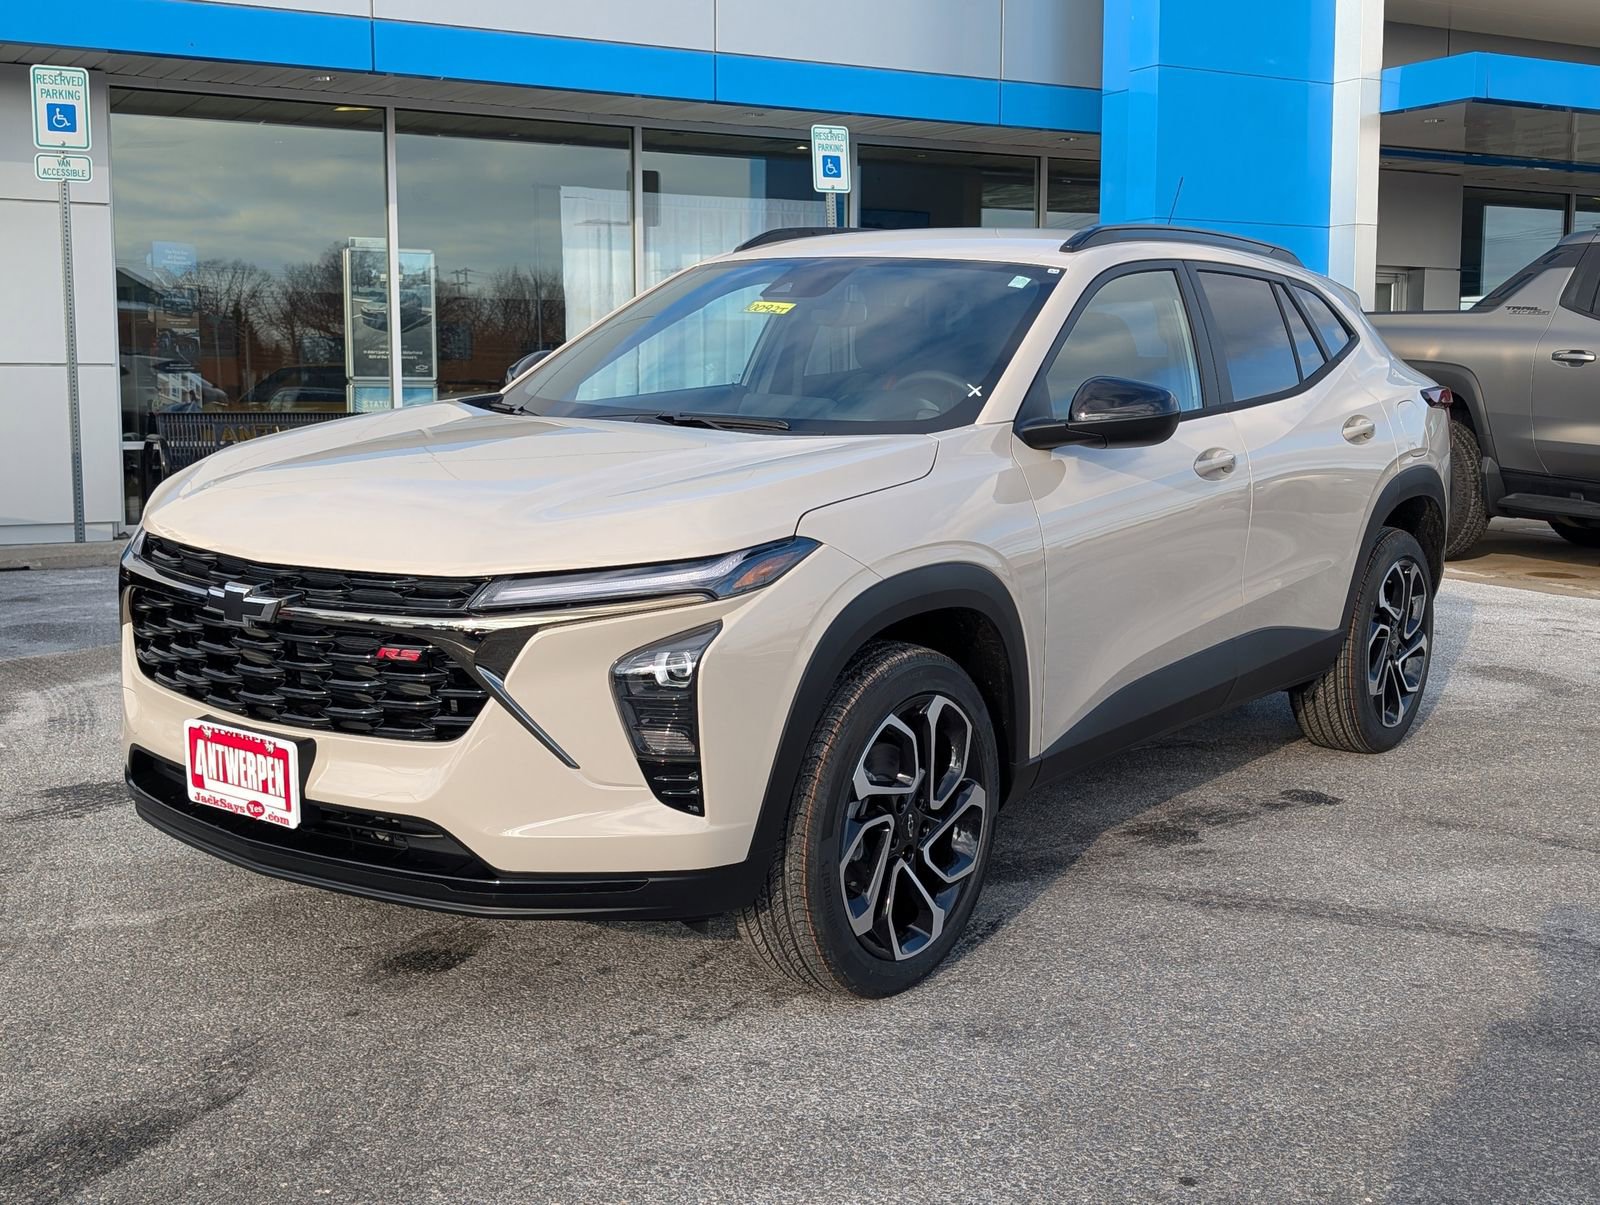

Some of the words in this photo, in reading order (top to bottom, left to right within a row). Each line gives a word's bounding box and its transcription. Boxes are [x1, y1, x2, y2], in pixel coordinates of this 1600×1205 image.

[35, 73, 84, 87] RESERVED
[40, 88, 81, 101] PARKING
[815, 131, 846, 142] RESERVED
[817, 143, 844, 153] PARKING
[56, 159, 71, 168] VAN
[42, 168, 87, 178] ACCESSIBLE
[363, 400, 390, 409] STATU
[376, 646, 422, 662] RS
[194, 738, 287, 799] ANTWERPEN
